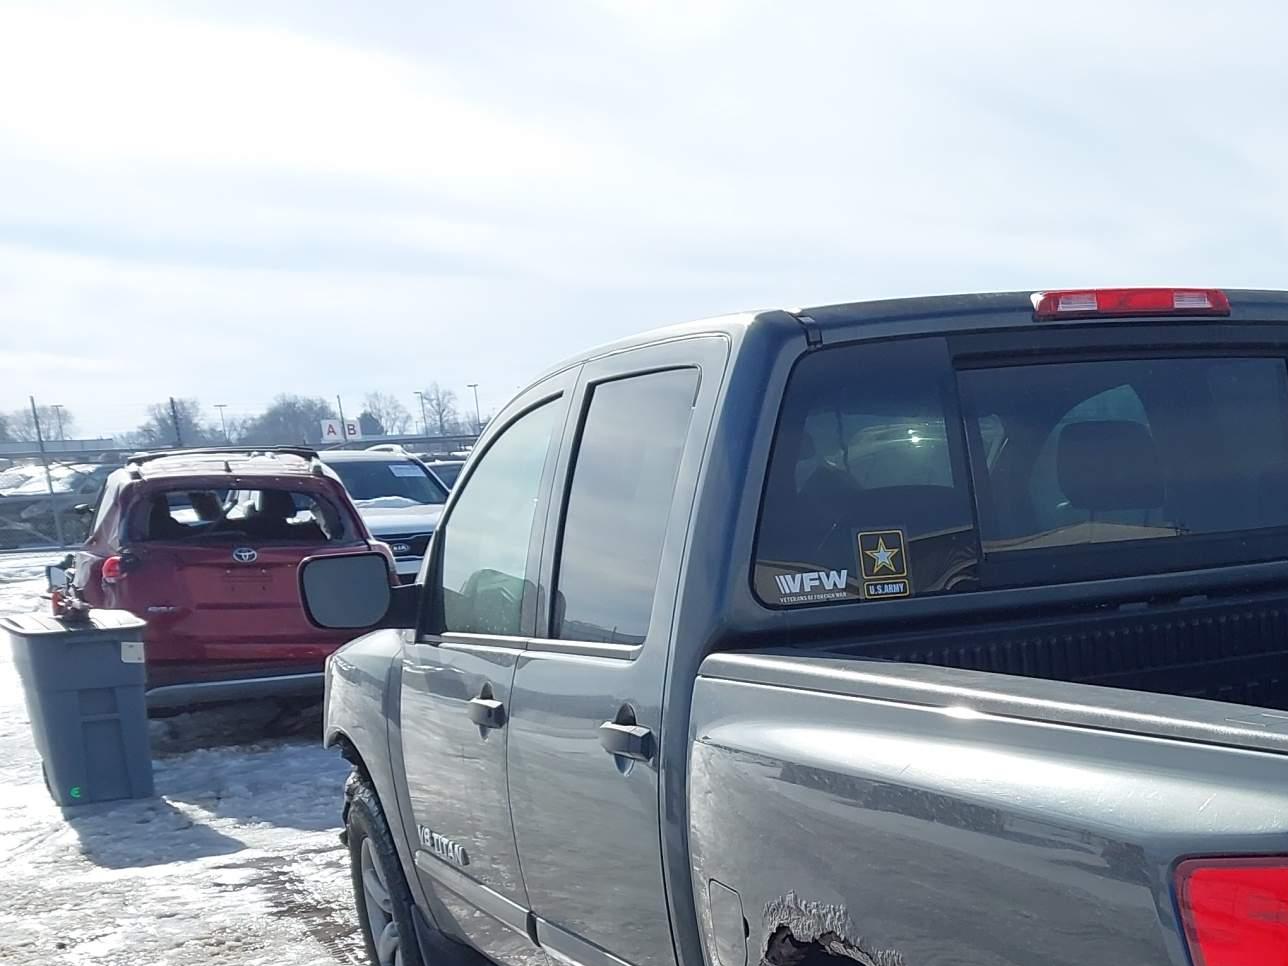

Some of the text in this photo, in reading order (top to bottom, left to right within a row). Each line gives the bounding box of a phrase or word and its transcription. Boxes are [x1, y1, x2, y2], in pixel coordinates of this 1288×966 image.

[327, 424, 337, 436] A
[347, 424, 356, 435] B
[778, 570, 848, 594] VFW
[432, 832, 467, 866] TITAN
